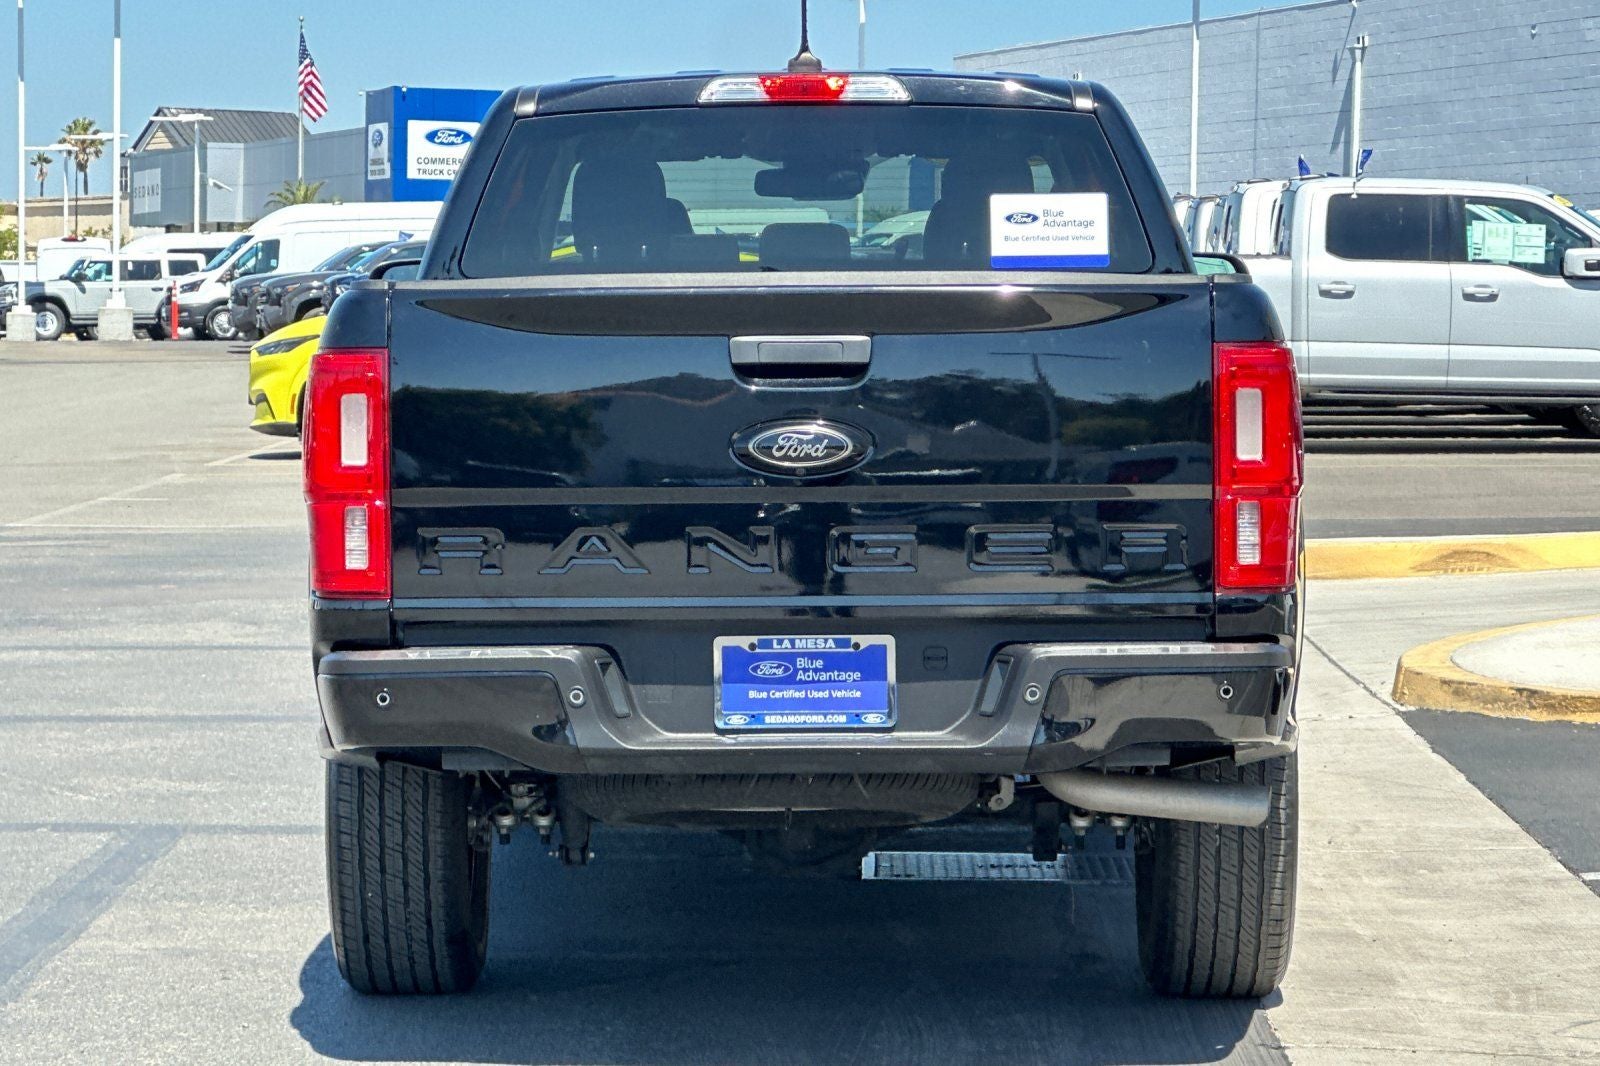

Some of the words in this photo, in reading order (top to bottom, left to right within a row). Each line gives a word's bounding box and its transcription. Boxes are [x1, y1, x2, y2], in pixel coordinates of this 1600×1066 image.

[434, 130, 464, 144] Ford
[417, 168, 444, 176] TRUCK
[1011, 213, 1034, 223] Ford
[1043, 209, 1064, 217] Blue
[1043, 219, 1095, 228] Advantage
[772, 433, 829, 458] Ford
[416, 523, 1188, 575] RANGER
[773, 639, 791, 648] LA
[795, 639, 835, 648] MESA
[796, 658, 823, 669] Blue
[757, 663, 784, 676] Ford
[796, 670, 861, 683] Advantage
[749, 690, 768, 699] Blue
[770, 689, 804, 698] Certified
[807, 689, 829, 698] Used
[831, 689, 861, 698] Vehicle
[764, 714, 847, 724] SEDANOFORD.COM
